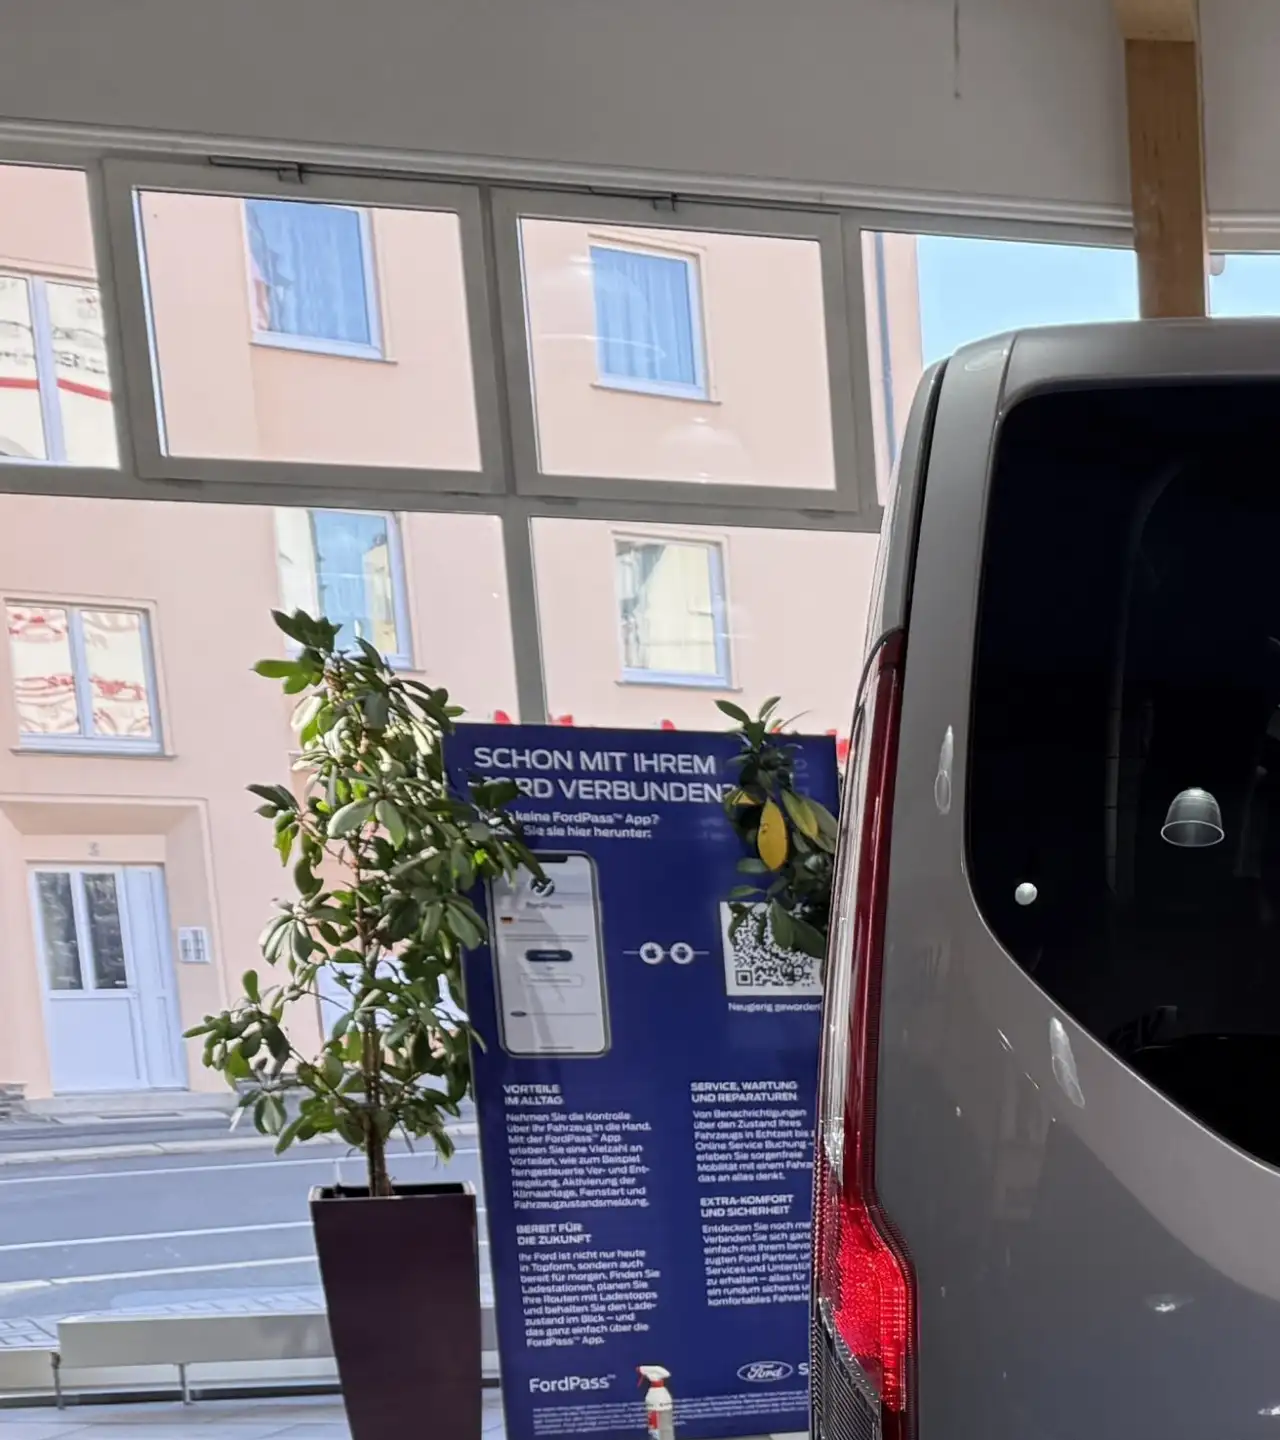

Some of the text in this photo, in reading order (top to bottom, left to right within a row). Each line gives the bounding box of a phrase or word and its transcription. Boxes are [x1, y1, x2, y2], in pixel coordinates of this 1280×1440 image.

[474, 748, 716, 775] SCHON MIT IHREM
[516, 812, 551, 821] keine
[625, 814, 659, 825] App?
[568, 826, 591, 836] hier
[503, 1084, 560, 1094] VORTEILE
[742, 1081, 797, 1090] WARTUNG
[505, 1096, 563, 1105] IM ALLTAG
[692, 1092, 797, 1102] UND REPARATUREN
[700, 1195, 794, 1207] EXTRA-KOMFORT
[701, 1205, 790, 1217] UND SICHERHEIT
[516, 1222, 582, 1234] BEREIT FÜR
[518, 1234, 591, 1245] DIE ZUKUNFT
